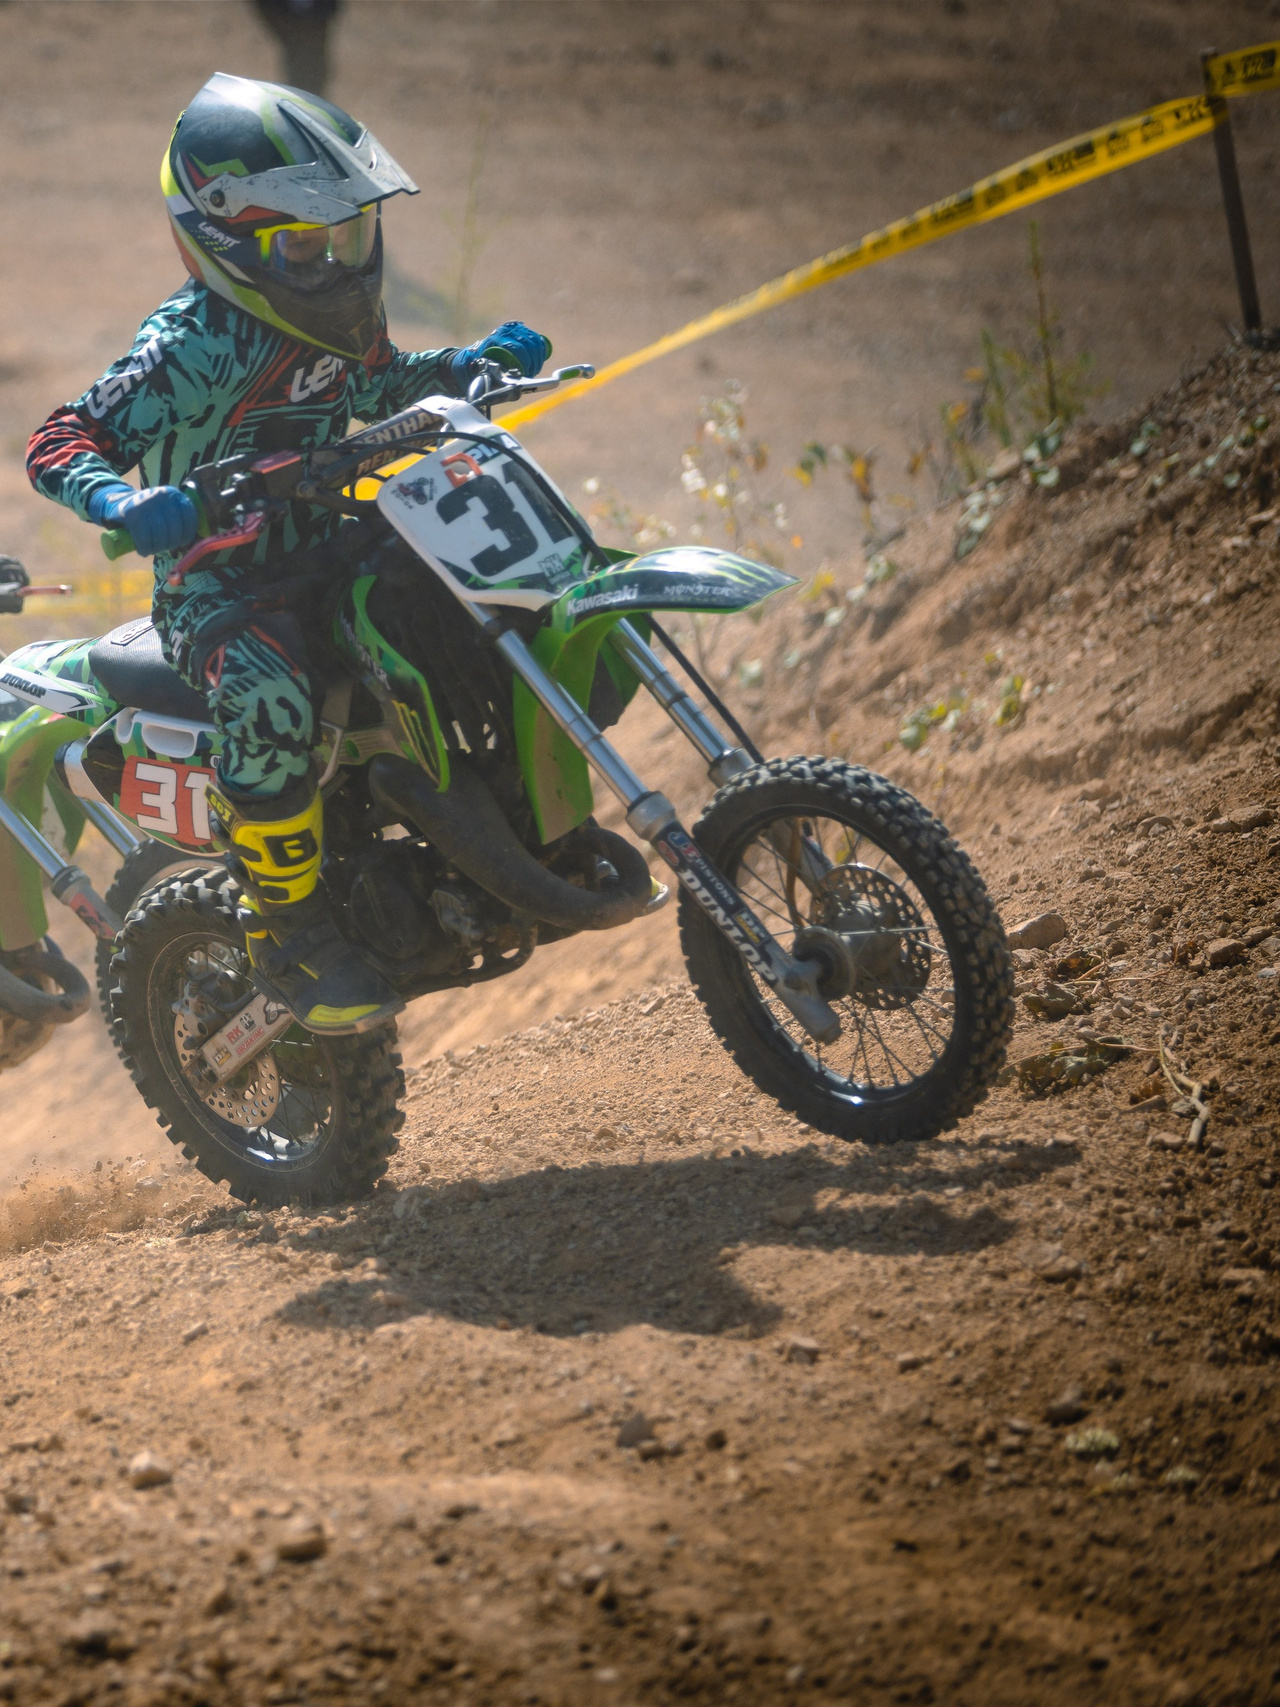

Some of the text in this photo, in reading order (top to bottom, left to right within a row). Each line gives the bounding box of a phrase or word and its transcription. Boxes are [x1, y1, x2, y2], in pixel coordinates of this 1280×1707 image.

[353, 412, 441, 444] ENTHA
[436, 460, 573, 577] 31
[566, 584, 638, 616] Kawasaki
[0, 672, 47, 698] DUNLOP
[135, 762, 212, 840] 31
[678, 868, 777, 981] DUNLOP
[236, 1026, 265, 1056] BRAKING
